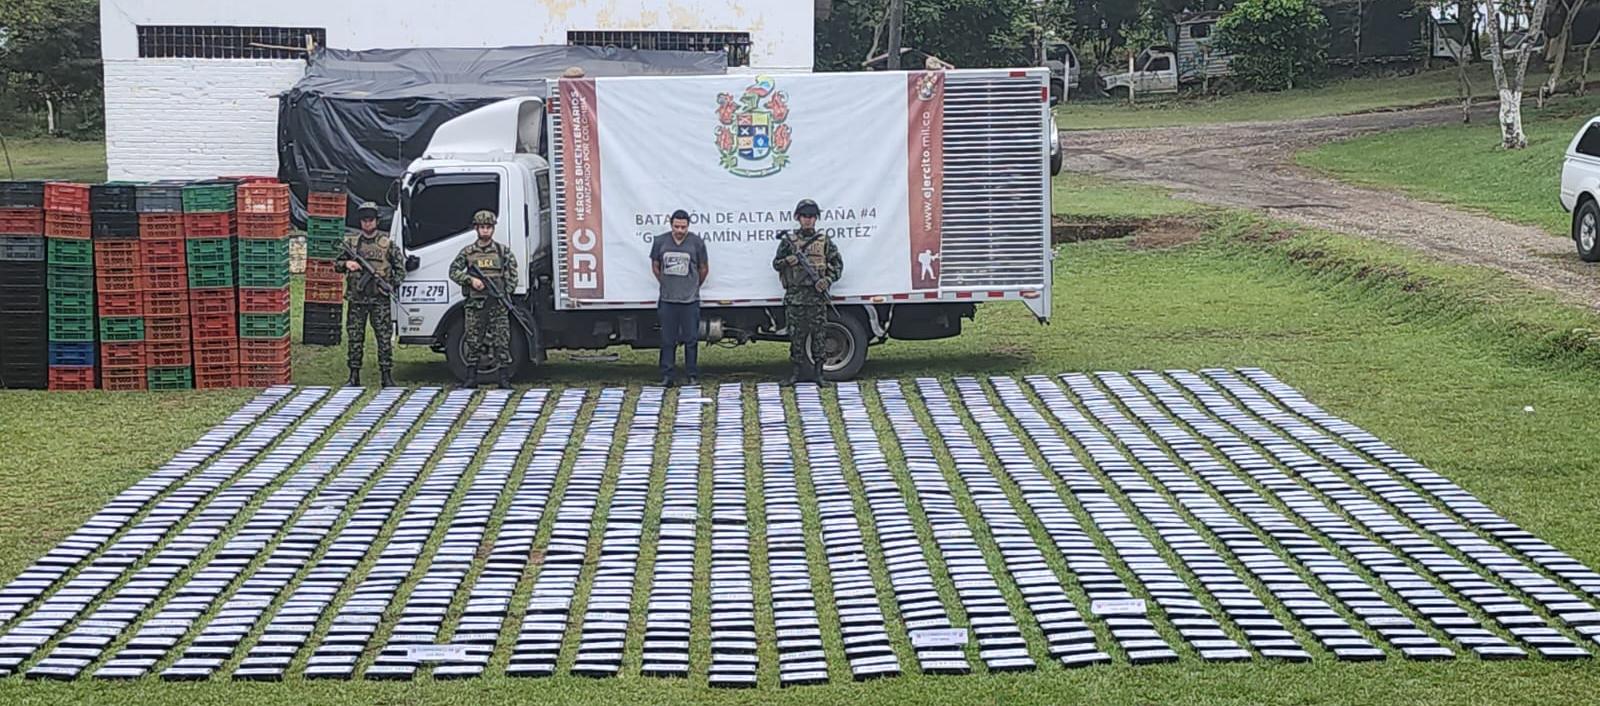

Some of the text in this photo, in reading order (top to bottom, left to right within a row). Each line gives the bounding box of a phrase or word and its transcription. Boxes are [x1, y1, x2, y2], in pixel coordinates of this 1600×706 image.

[570, 90, 585, 221] HÉROES BICENTENARIOS
[582, 143, 591, 160] POR
[920, 111, 935, 232] www.ejercito.mil.co
[583, 163, 592, 214] AVANZANDO
[635, 206, 877, 225] BATAÓN DE ALTA MTAÑA #4
[572, 228, 597, 289] EJC
[401, 285, 445, 297] TST 279
